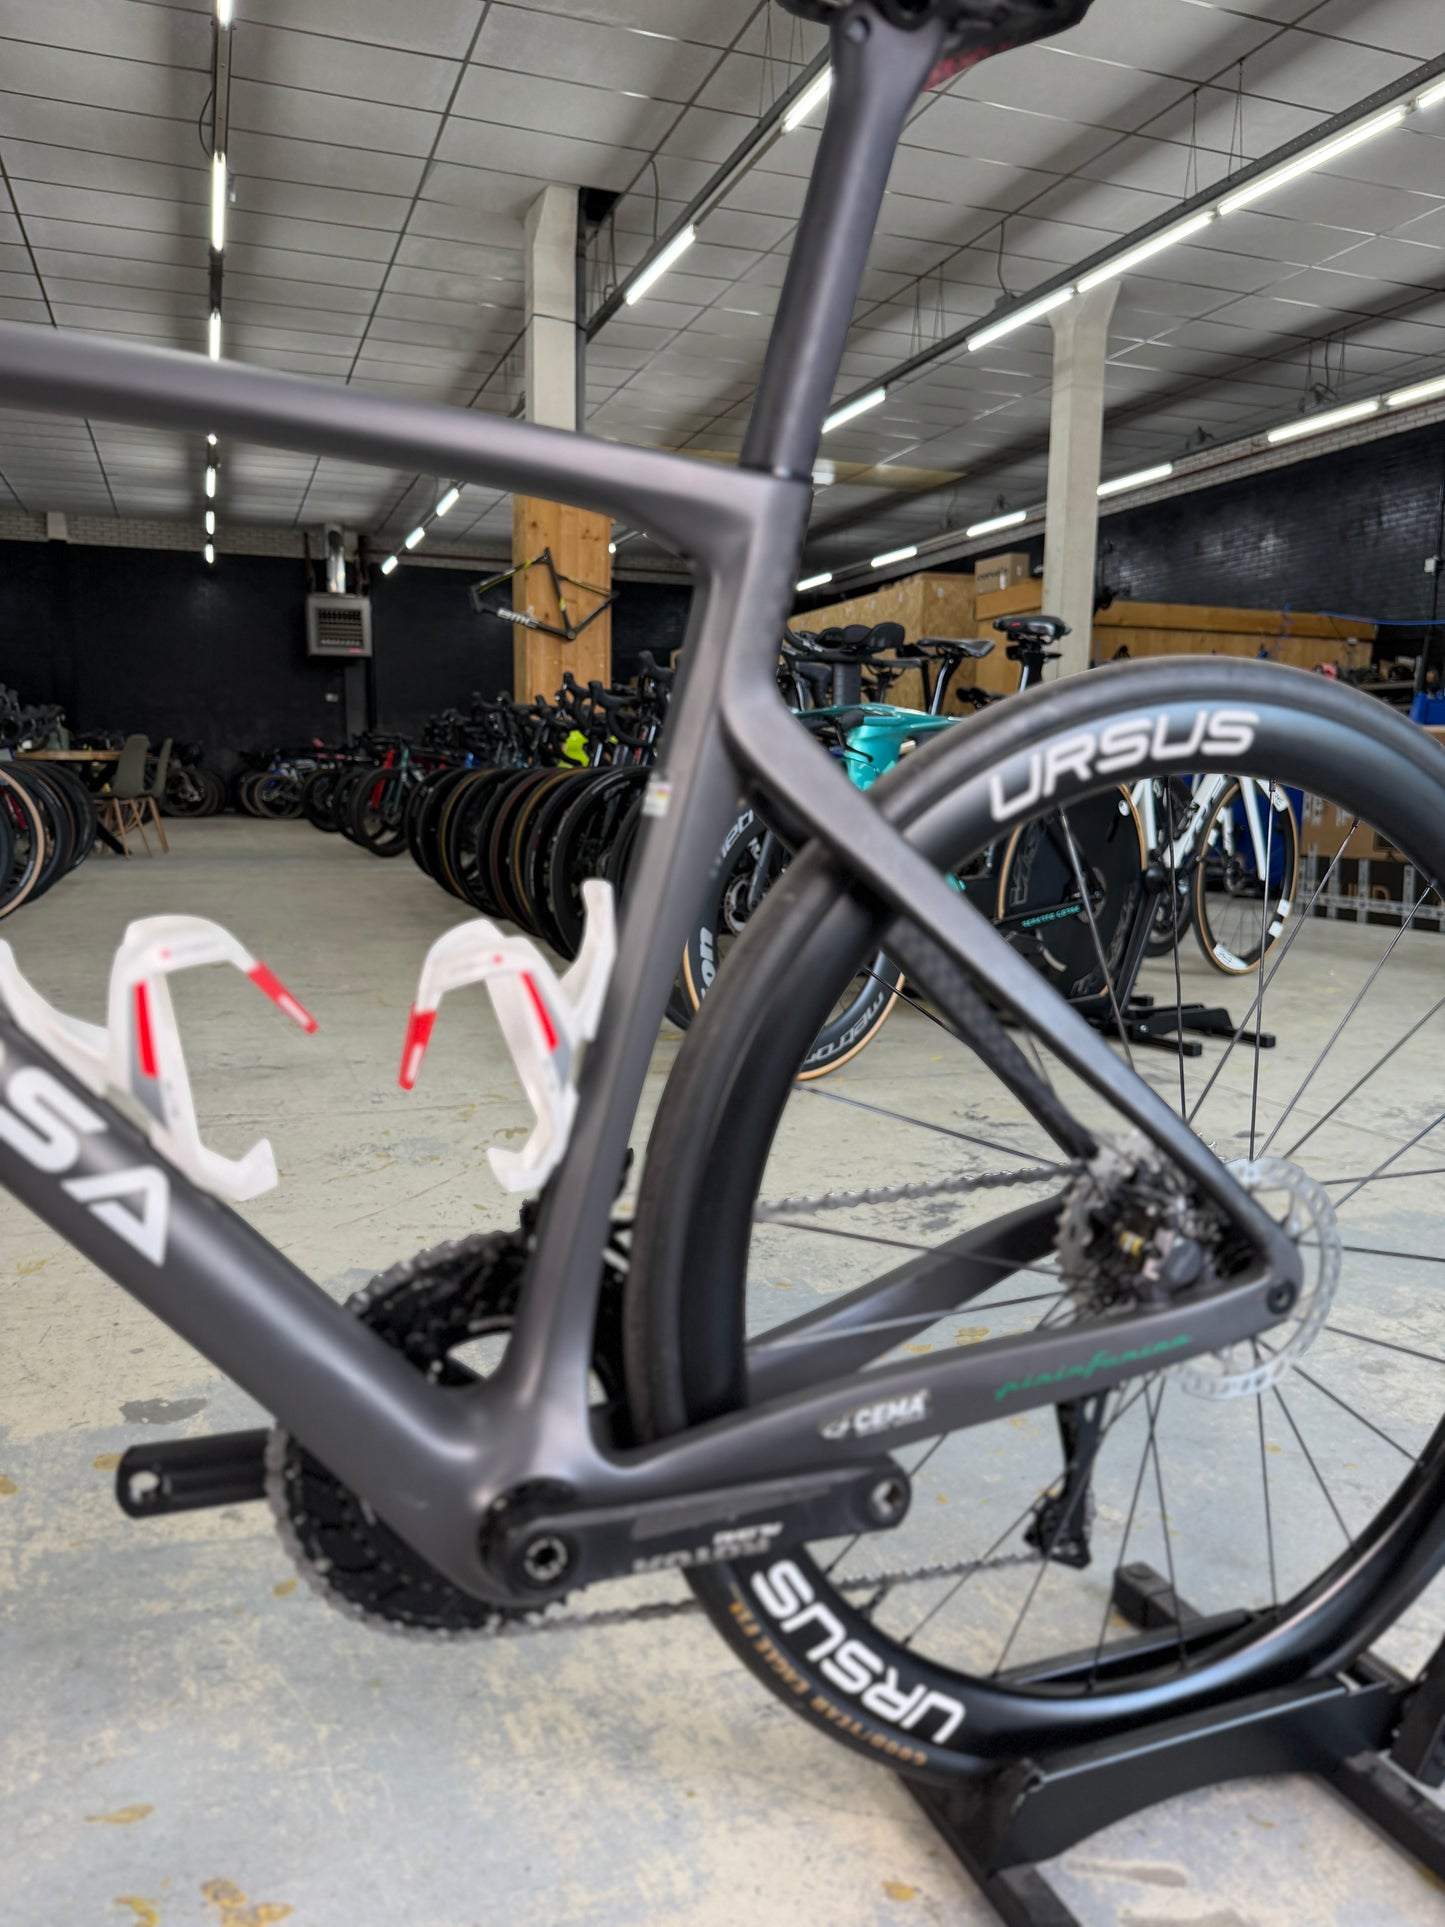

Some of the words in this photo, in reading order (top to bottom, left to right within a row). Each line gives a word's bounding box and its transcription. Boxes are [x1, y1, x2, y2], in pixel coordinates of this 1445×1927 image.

[990, 710, 1259, 821] URSUS
[0, 1066, 170, 1267] SA
[750, 1560, 966, 1744] URSUS
